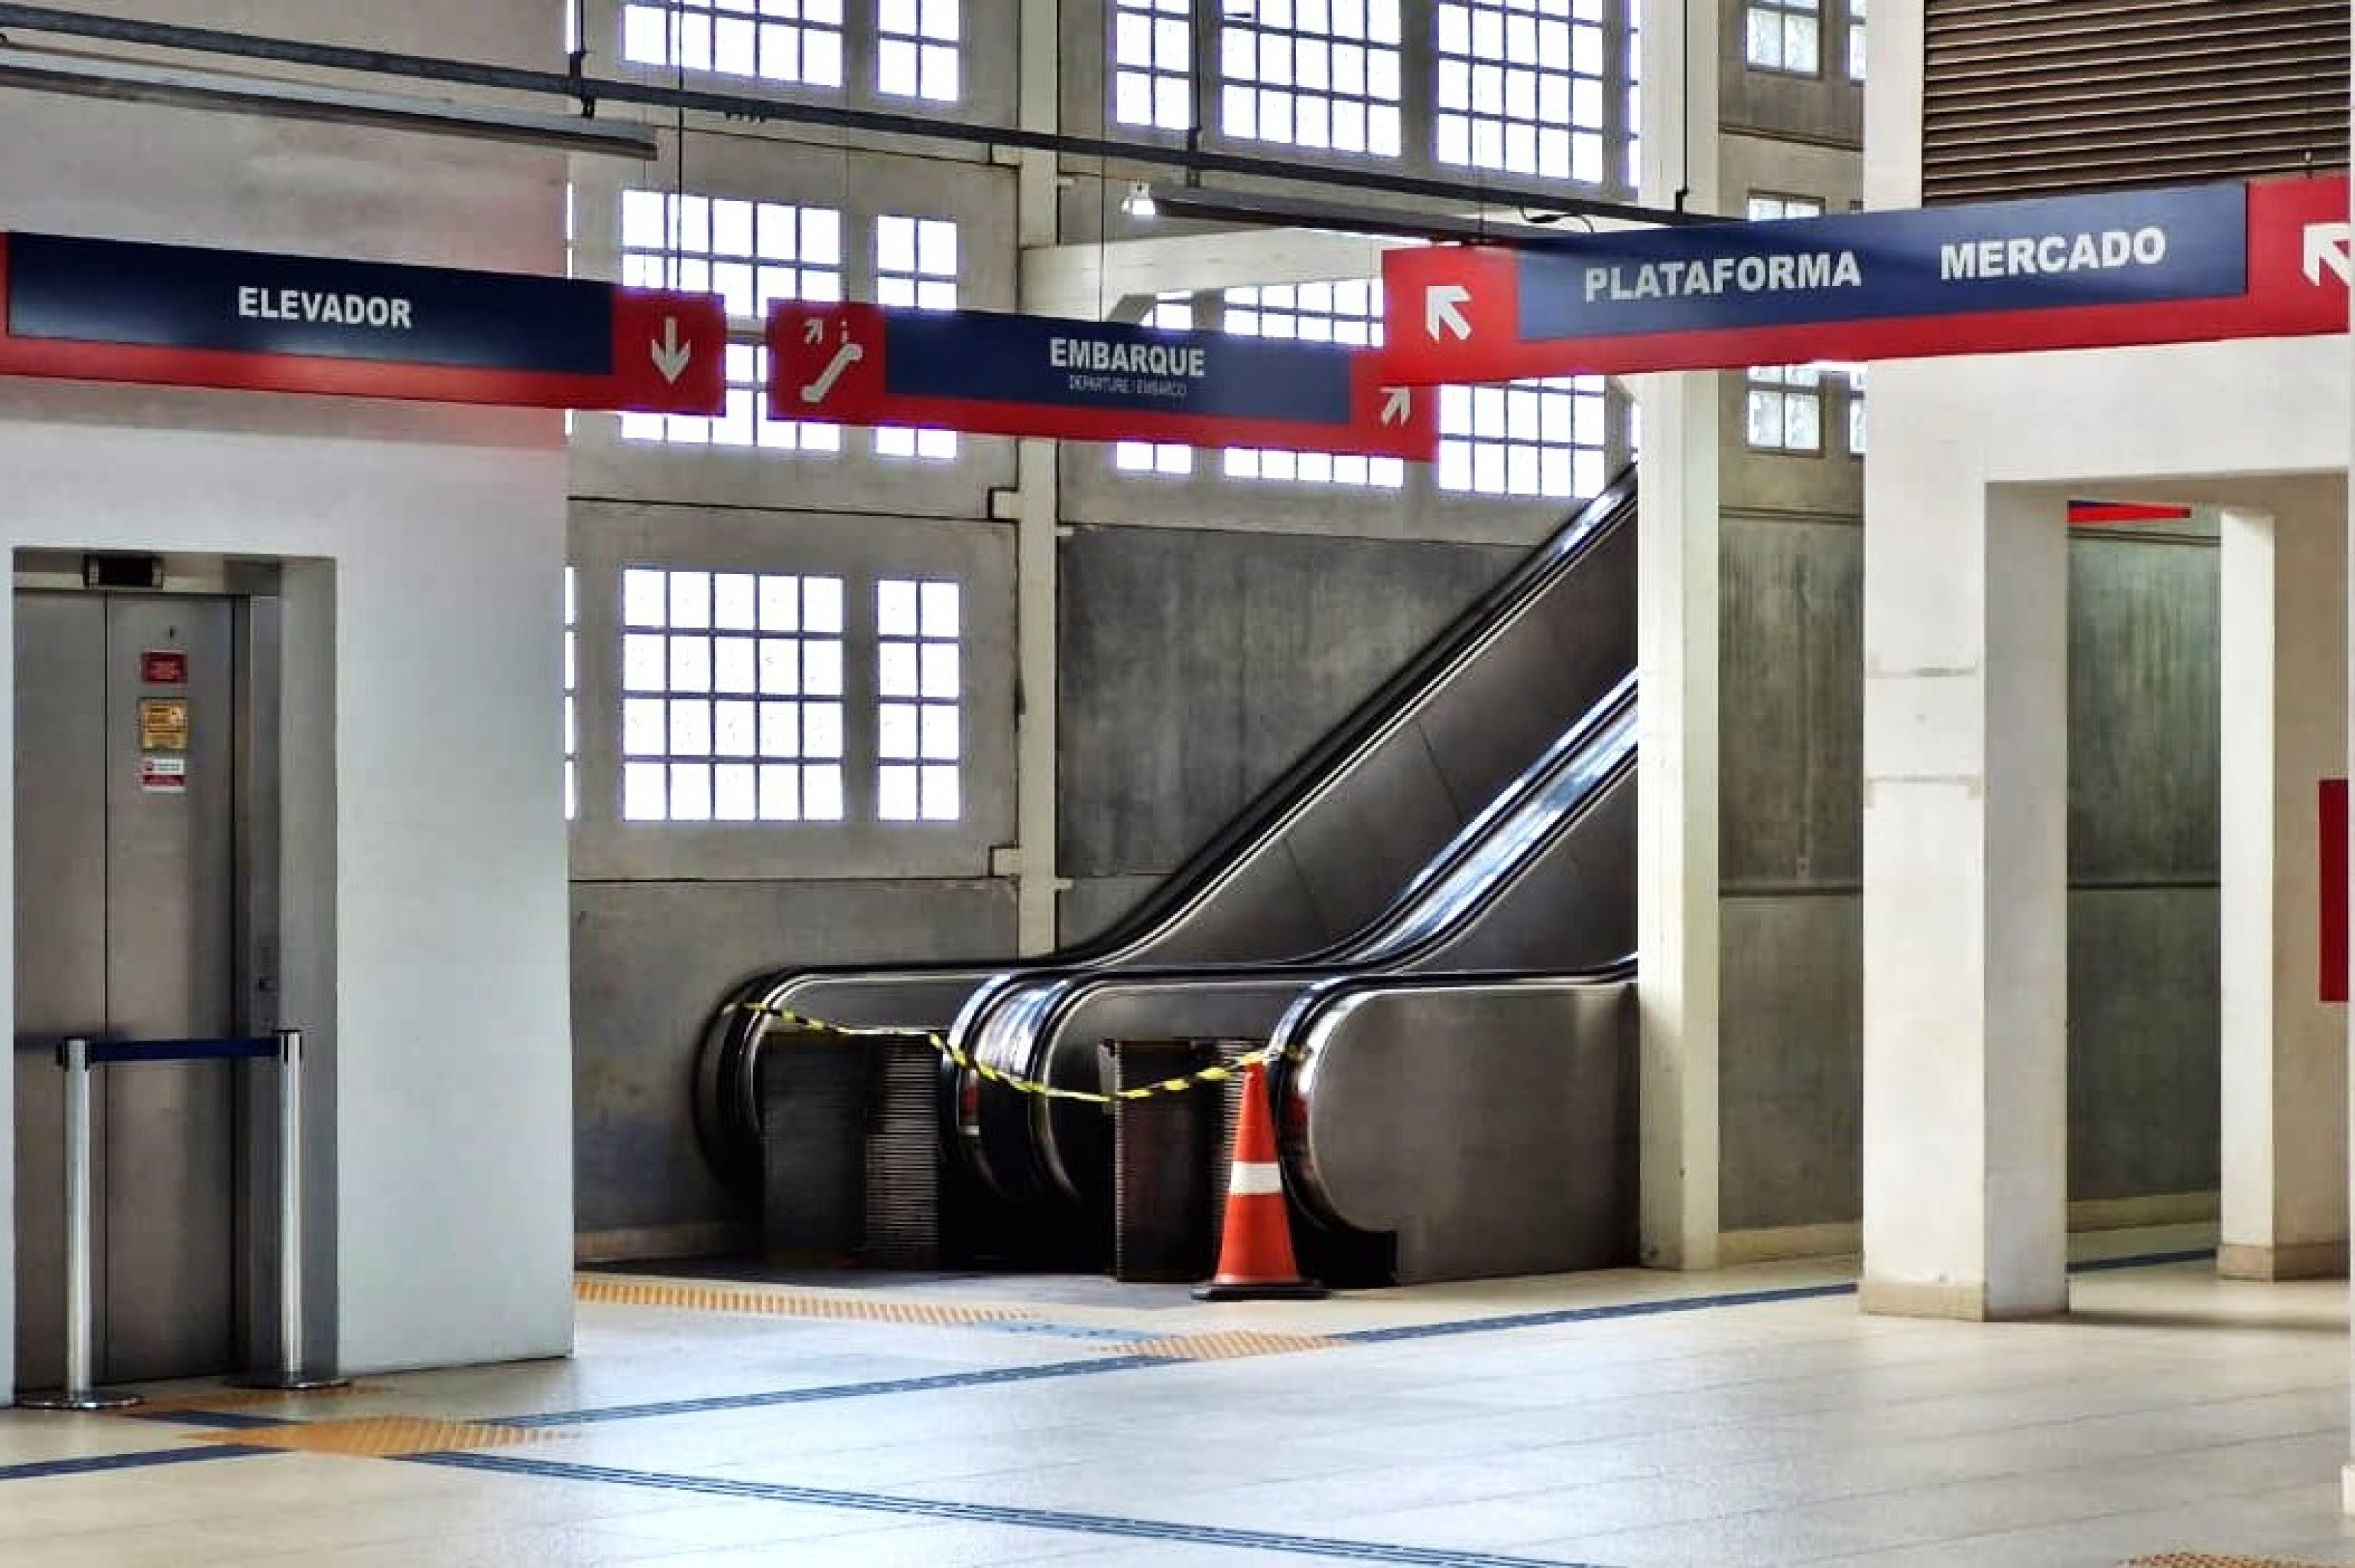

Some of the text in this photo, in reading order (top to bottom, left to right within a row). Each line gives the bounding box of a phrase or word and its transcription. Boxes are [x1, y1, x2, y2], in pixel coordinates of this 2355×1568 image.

[1584, 227, 2165, 303] PLATAFORMA MERCADO
[239, 285, 411, 328] ELEVADOR
[1050, 337, 1205, 376] EMBARQUE
